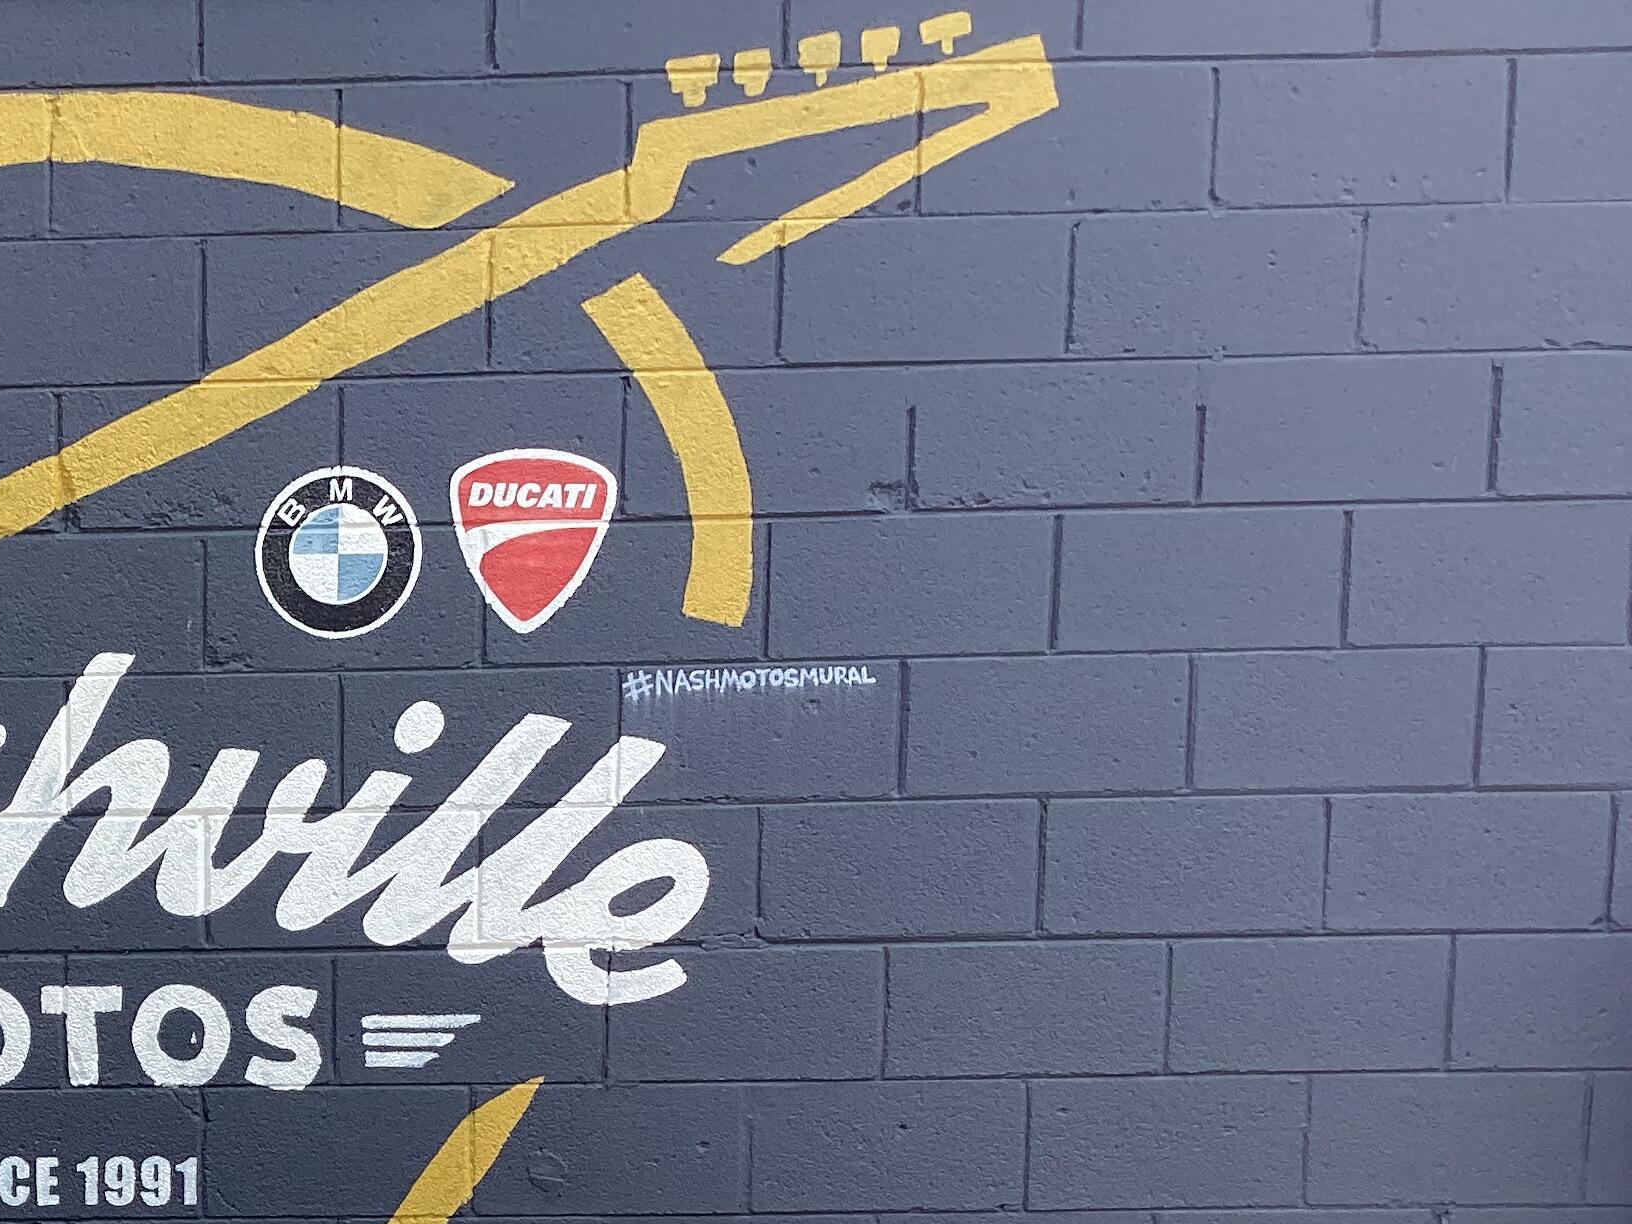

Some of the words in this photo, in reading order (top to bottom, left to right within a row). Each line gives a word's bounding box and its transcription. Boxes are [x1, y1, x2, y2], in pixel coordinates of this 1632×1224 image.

[277, 479, 404, 527] BMW
[469, 481, 598, 509] DUCATI
[621, 664, 877, 702] #NASHMOTOSMURAL
[76, 1154, 198, 1207] 1991
